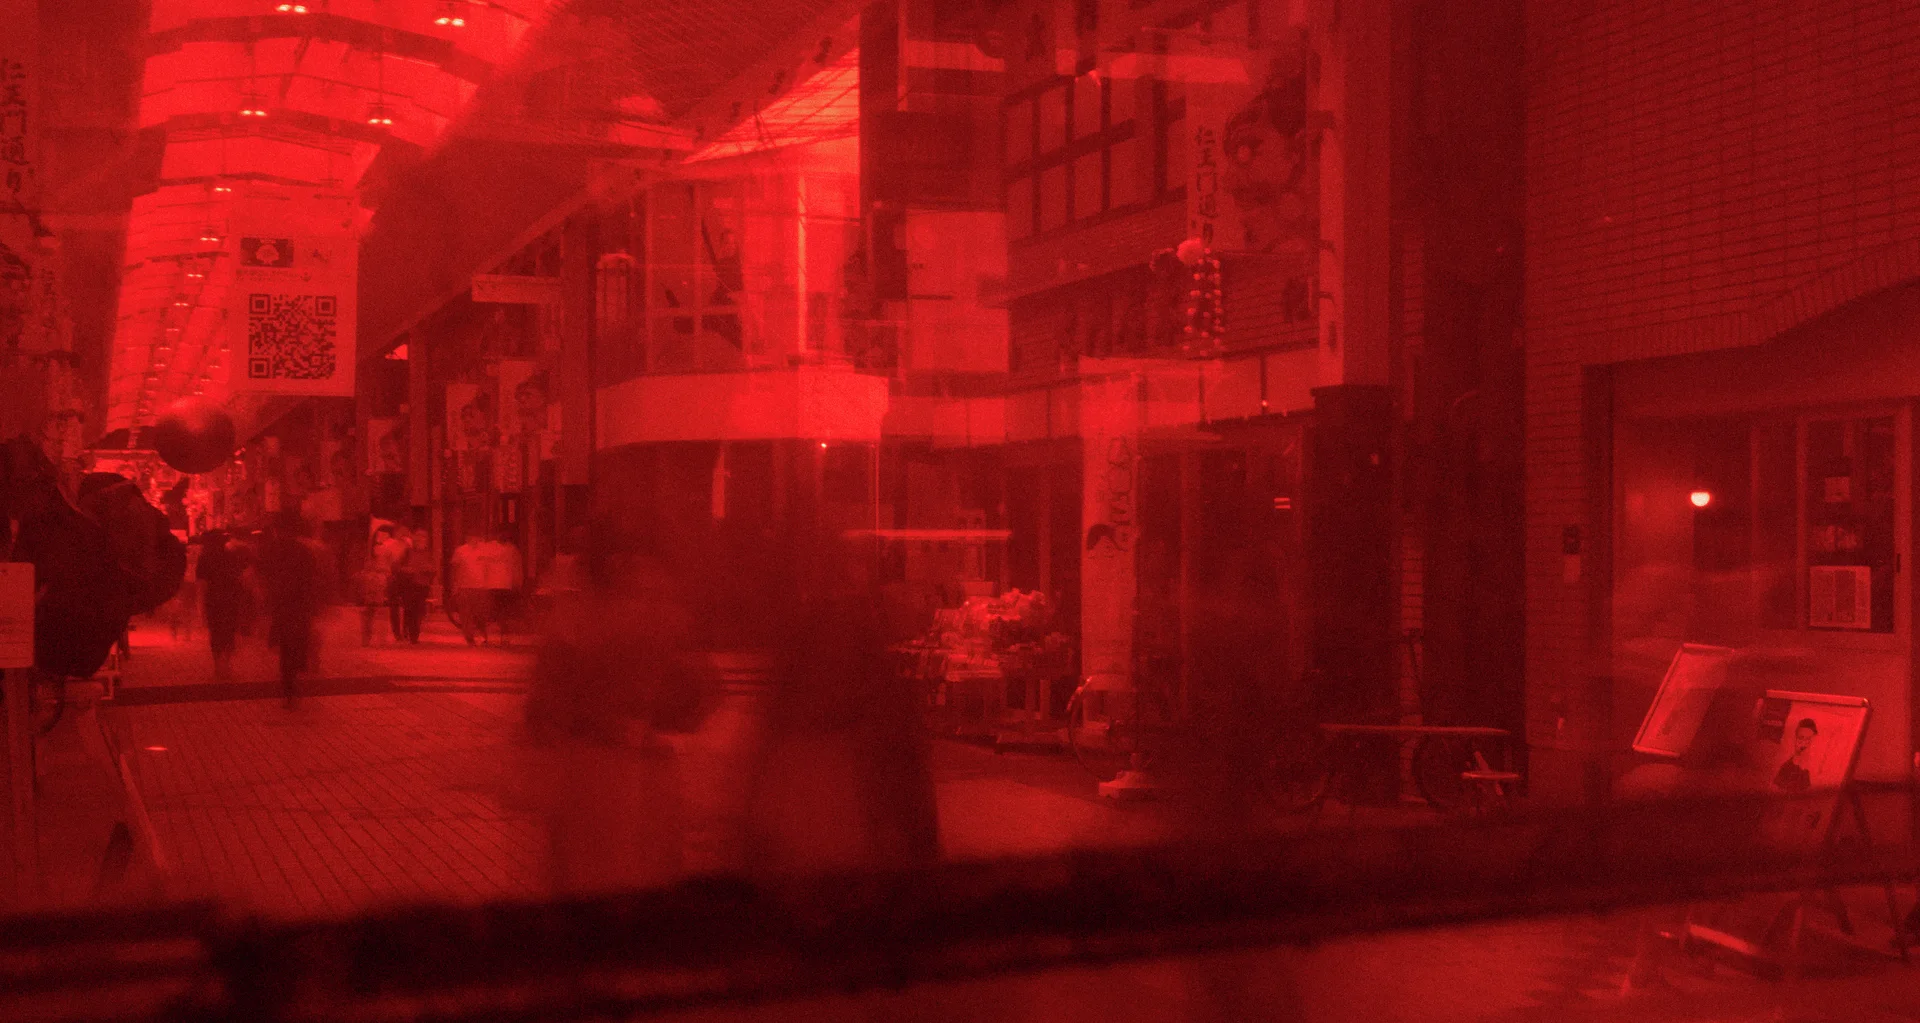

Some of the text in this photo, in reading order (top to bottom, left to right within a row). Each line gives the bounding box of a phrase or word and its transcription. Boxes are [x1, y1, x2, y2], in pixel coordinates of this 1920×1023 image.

[1195, 125, 1220, 245] 仁王門通り
